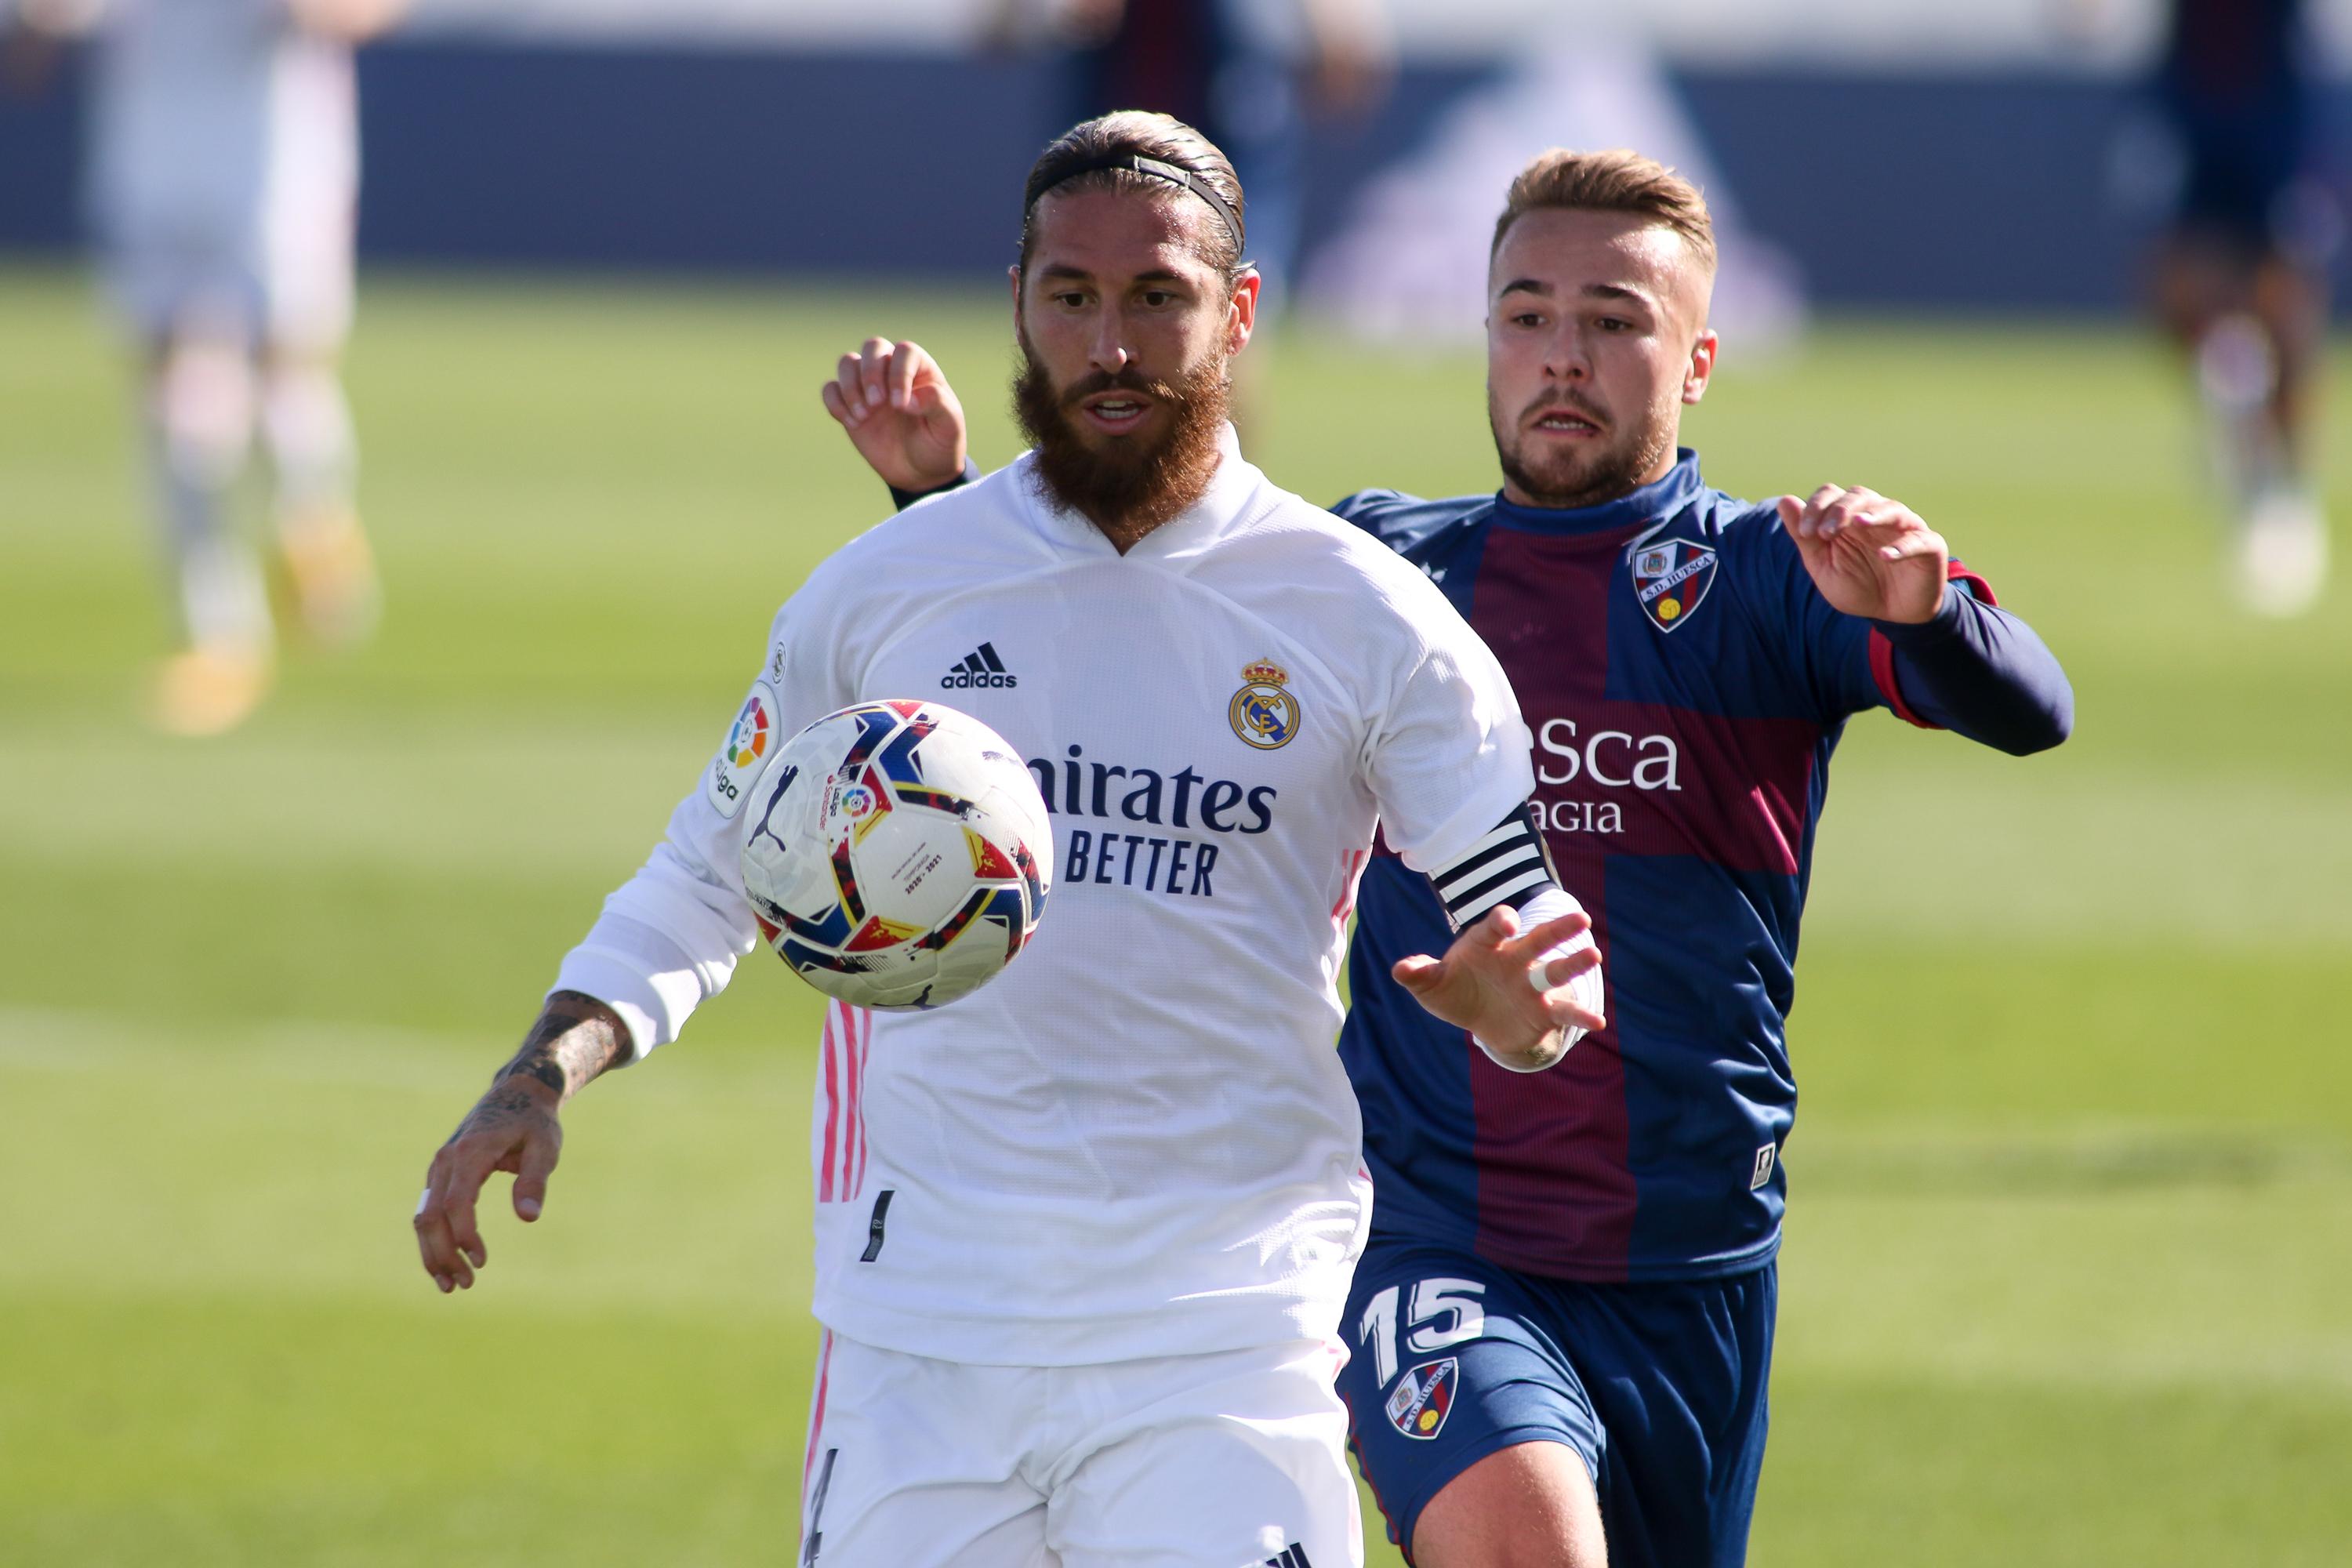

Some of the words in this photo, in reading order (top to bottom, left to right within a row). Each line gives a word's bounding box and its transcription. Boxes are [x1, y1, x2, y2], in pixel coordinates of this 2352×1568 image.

[1646, 583, 1668, 598] S.D.
[1667, 556, 1711, 586] HUESCA
[941, 670, 1018, 689] adidas
[1526, 718, 1682, 791] Sca
[819, 786, 833, 831] Santander
[905, 876, 923, 895] 2020
[925, 854, 942, 873] 2021
[1065, 829, 1220, 897] BETTER
[1359, 1277, 1486, 1390] 15
[1418, 1367, 1450, 1404] HUESCA
